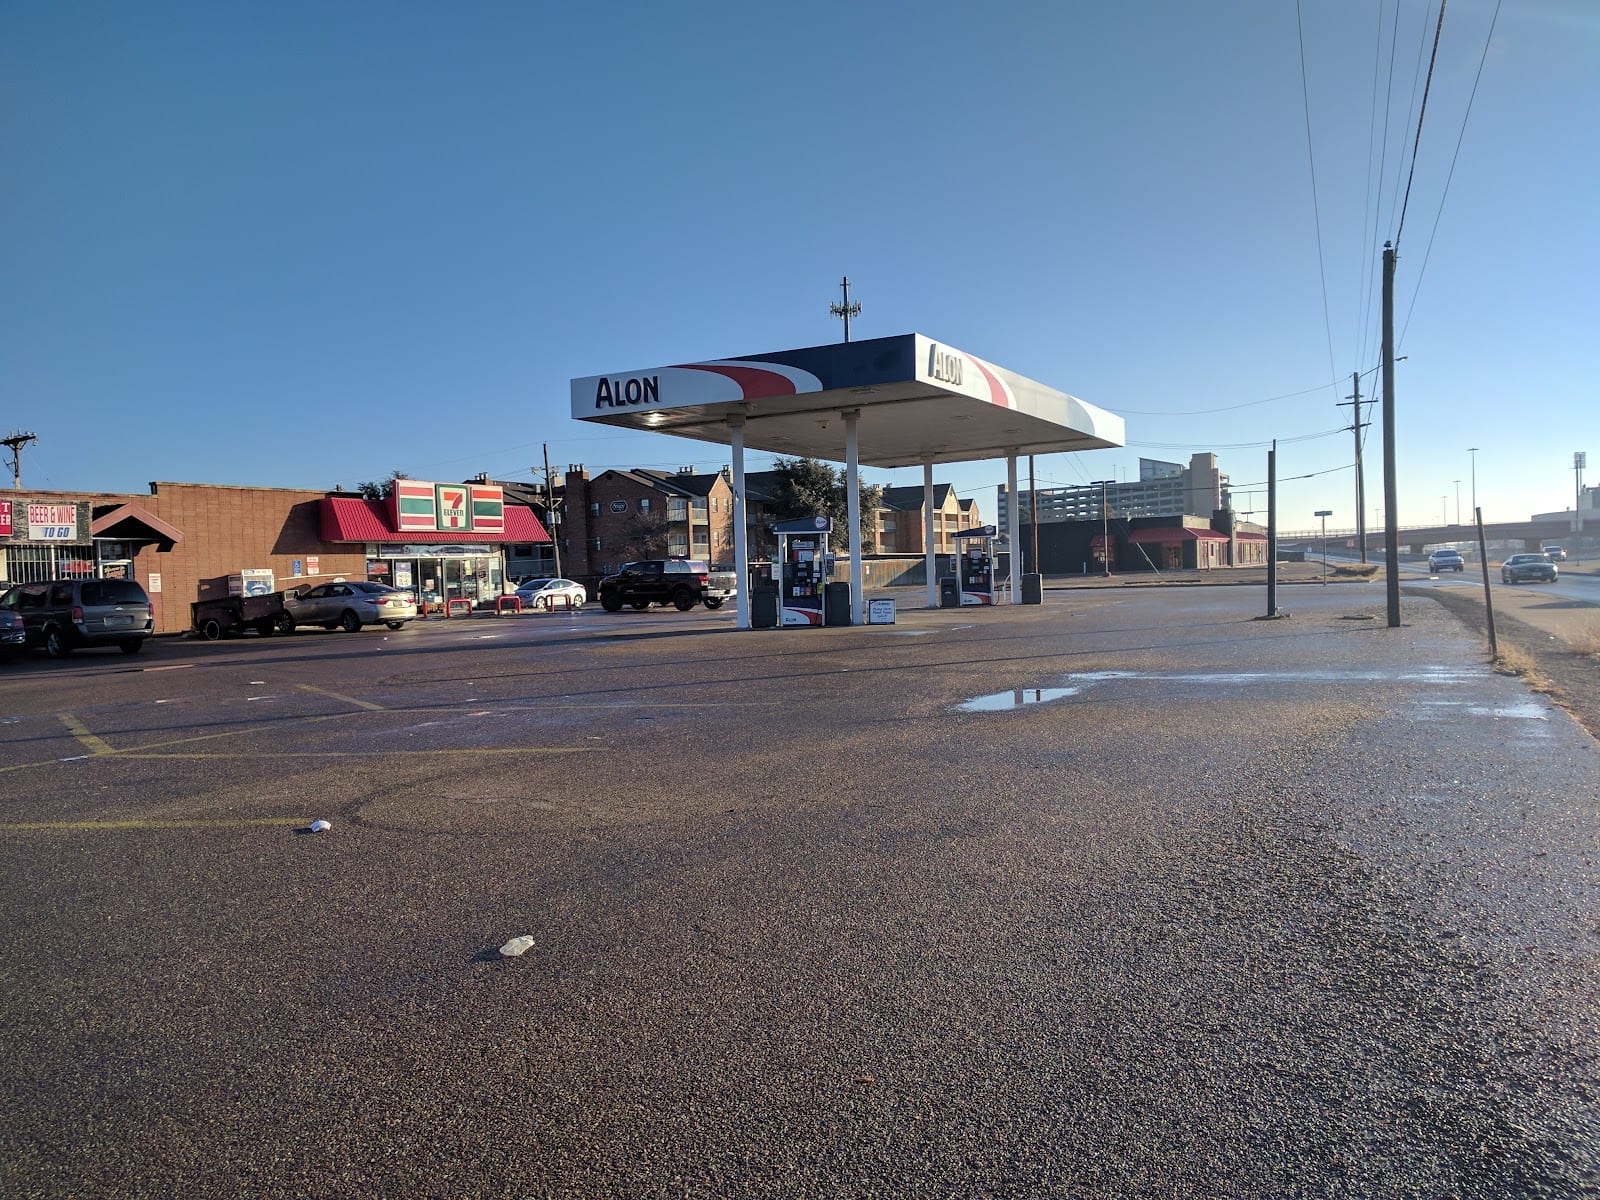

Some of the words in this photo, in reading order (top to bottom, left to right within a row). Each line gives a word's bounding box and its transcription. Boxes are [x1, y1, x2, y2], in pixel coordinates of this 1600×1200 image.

[928, 343, 963, 386] ALON
[595, 376, 660, 408] ALON
[1, 502, 11, 513] T
[30, 507, 48, 523] BEER
[50, 506, 55, 523] &
[57, 506, 75, 523] WINE
[444, 492, 463, 527] 7
[0, 514, 11, 525] ER
[44, 527, 55, 537] TO
[57, 527, 70, 537] GO
